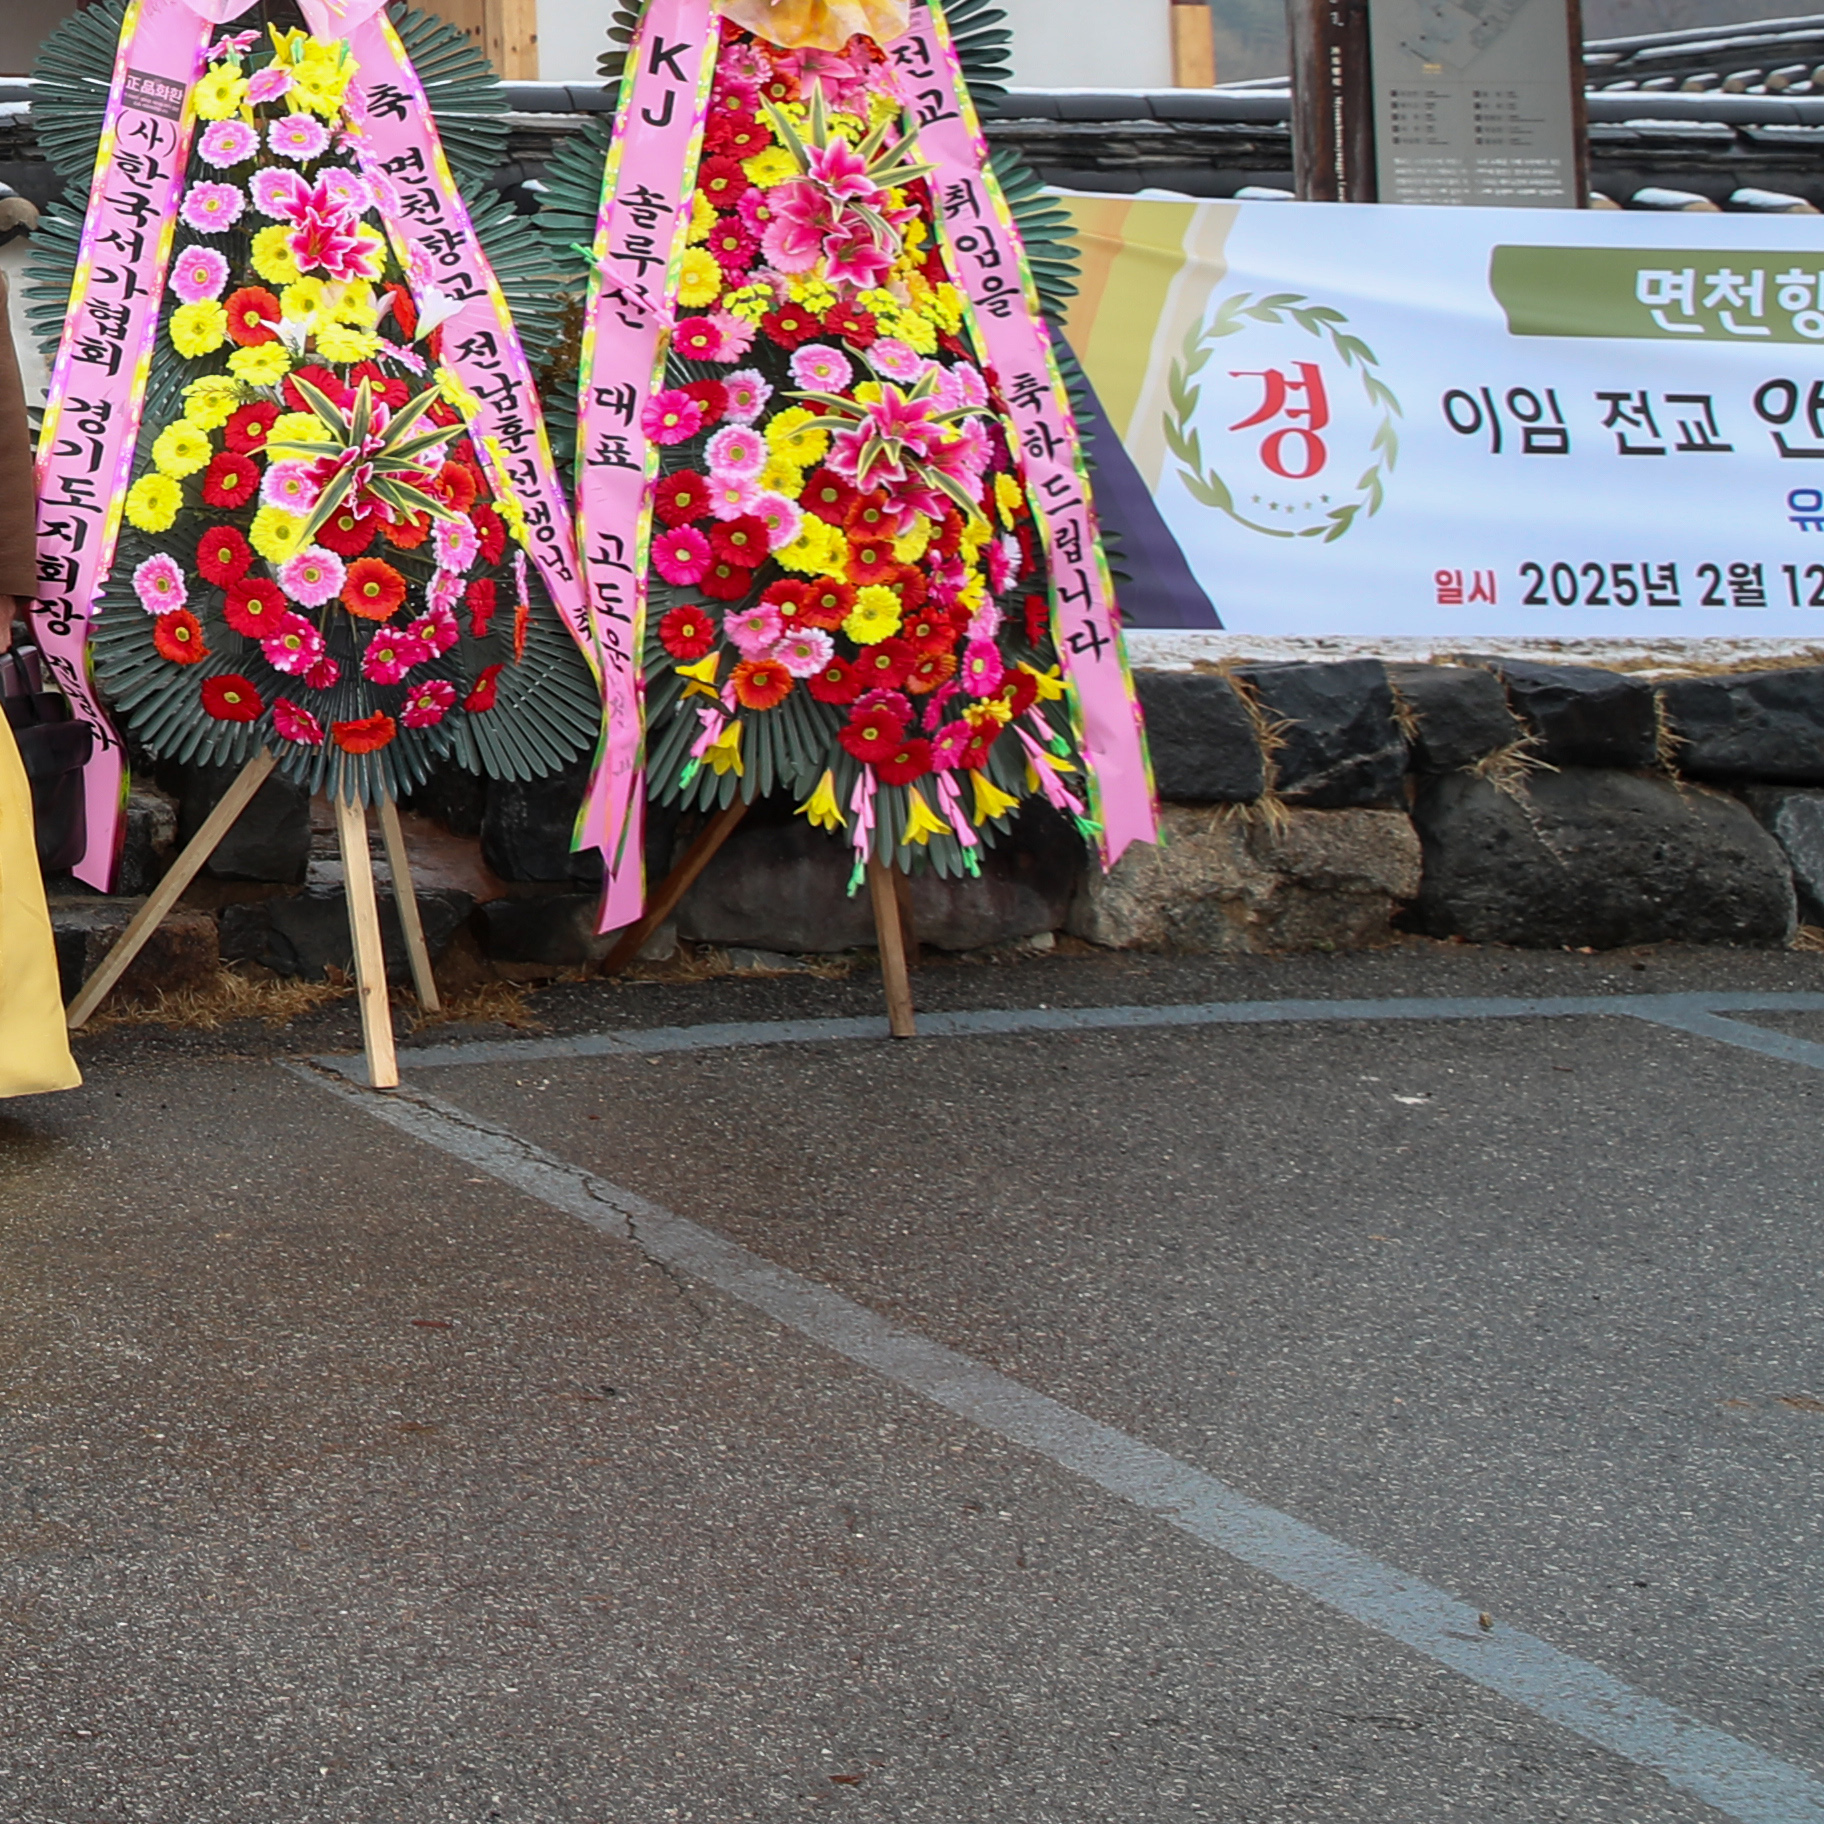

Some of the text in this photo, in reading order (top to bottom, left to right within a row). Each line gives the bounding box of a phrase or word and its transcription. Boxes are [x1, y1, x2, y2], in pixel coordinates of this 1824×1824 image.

[366, 82, 415, 122] 축
[640, 35, 694, 128] KJ
[378, 146, 488, 302] 면천향교
[890, 35, 1112, 664] 전교 취임을 축하드립니다
[587, 382, 643, 473] 대표
[1228, 360, 1331, 479] 경
[1442, 385, 1571, 455] 이임
[1593, 389, 1735, 457] 전교
[31, 396, 113, 637] 경기도지회장
[1433, 568, 1498, 606] 일시
[1518, 561, 1683, 608] 2025년
[1695, 561, 1768, 608] 2월
